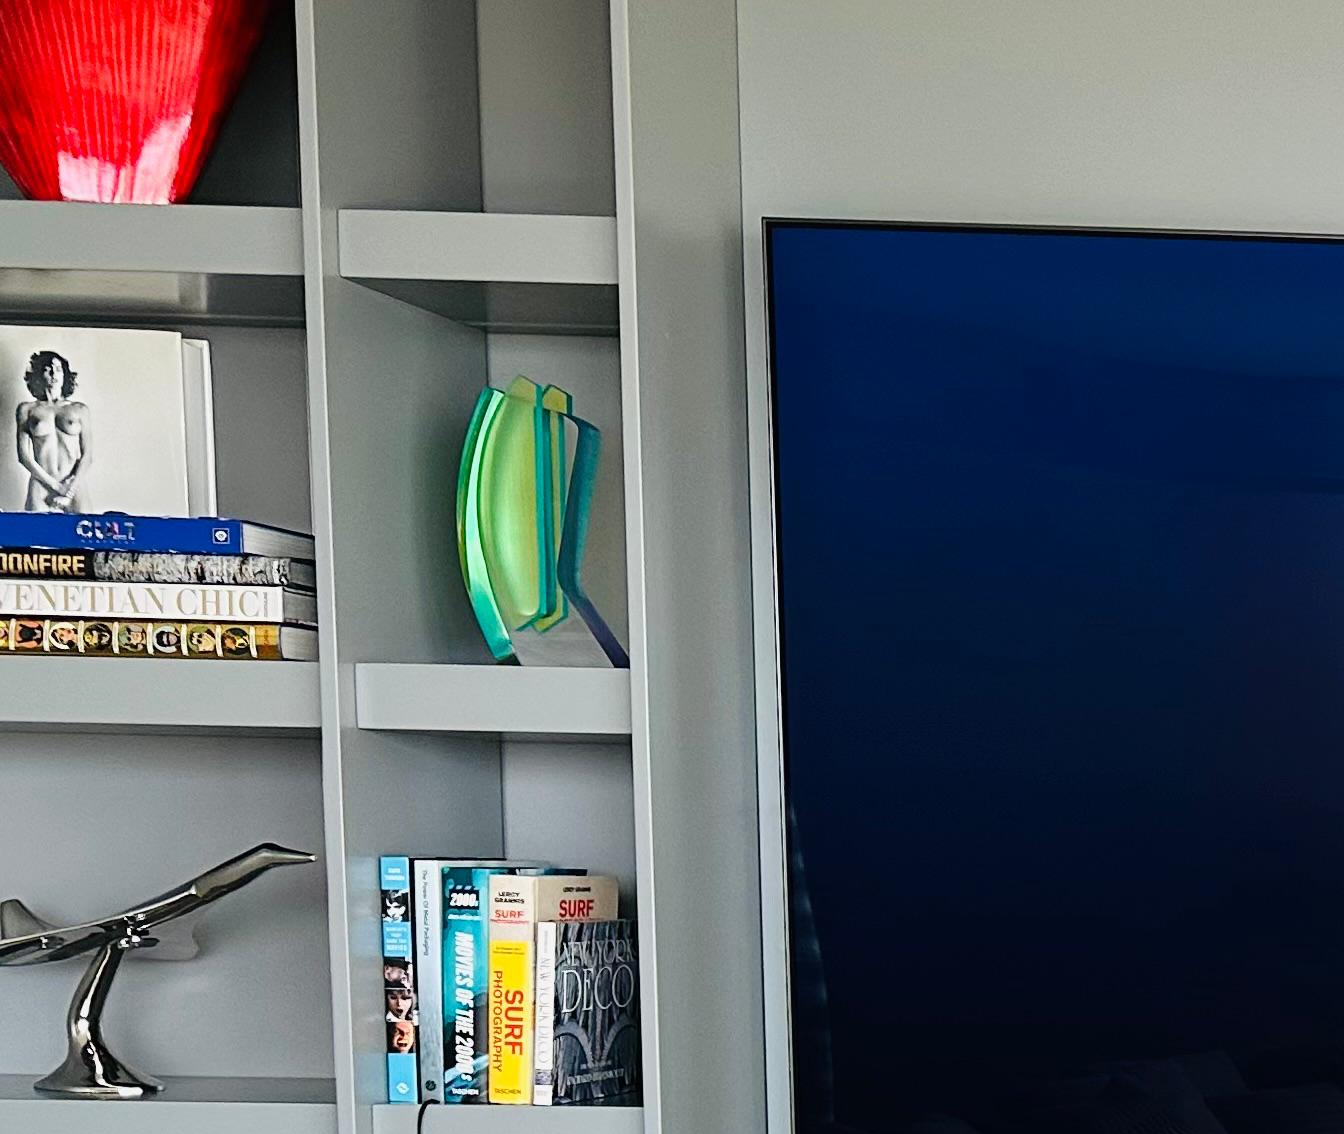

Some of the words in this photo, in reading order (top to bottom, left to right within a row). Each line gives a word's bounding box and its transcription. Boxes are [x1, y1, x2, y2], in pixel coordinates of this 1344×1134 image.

[177, 589, 259, 618] CHIC
[495, 909, 524, 919] SURF
[559, 899, 595, 918] SURF
[455, 931, 474, 988] MOVIES
[455, 988, 475, 1009] OF
[561, 964, 634, 1013] DECO
[455, 1009, 475, 1036] THE
[493, 971, 503, 1072] PHOTOGRAPHY
[505, 990, 524, 1056] SURF
